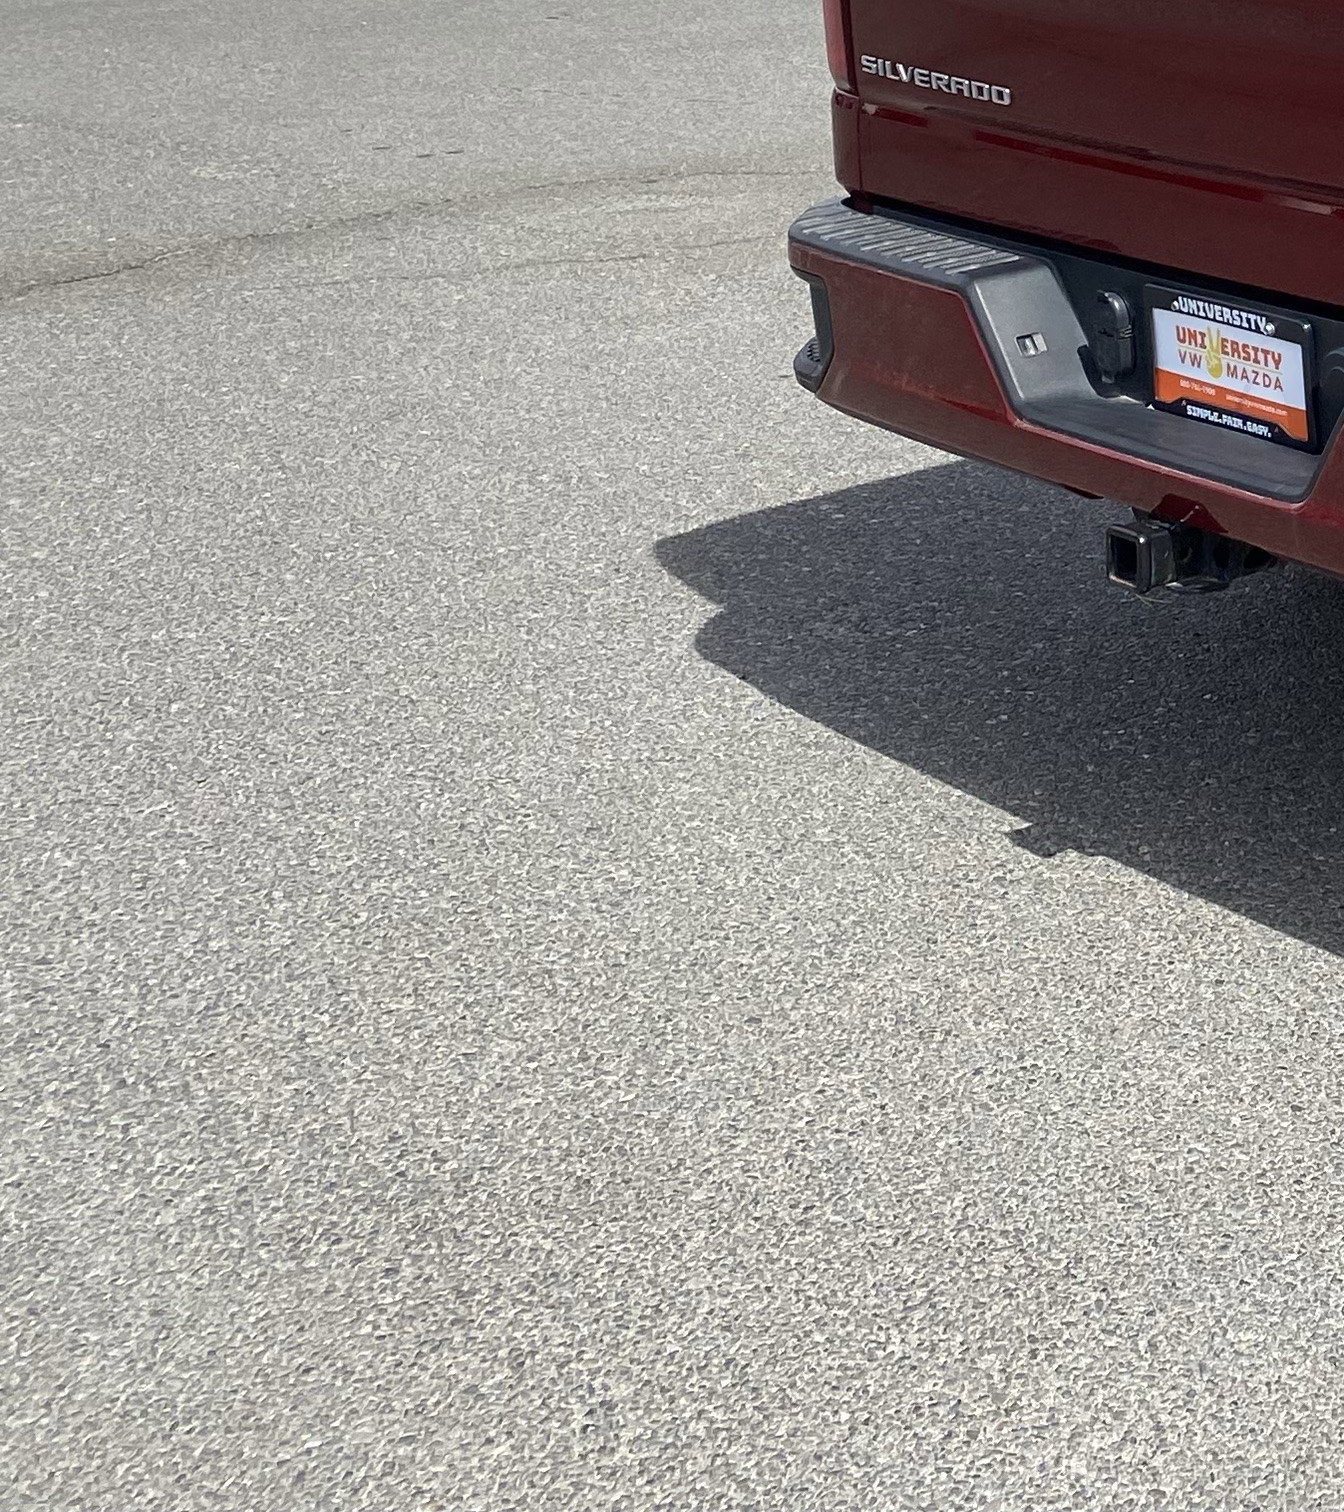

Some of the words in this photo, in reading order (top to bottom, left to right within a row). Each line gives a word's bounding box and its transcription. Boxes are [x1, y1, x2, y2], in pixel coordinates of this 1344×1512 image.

[860, 54, 1012, 106] SILVERADO
[1177, 296, 1268, 336] UNIVERSITY
[1178, 349, 1202, 369] VW
[1226, 363, 1284, 392] MAZDA
